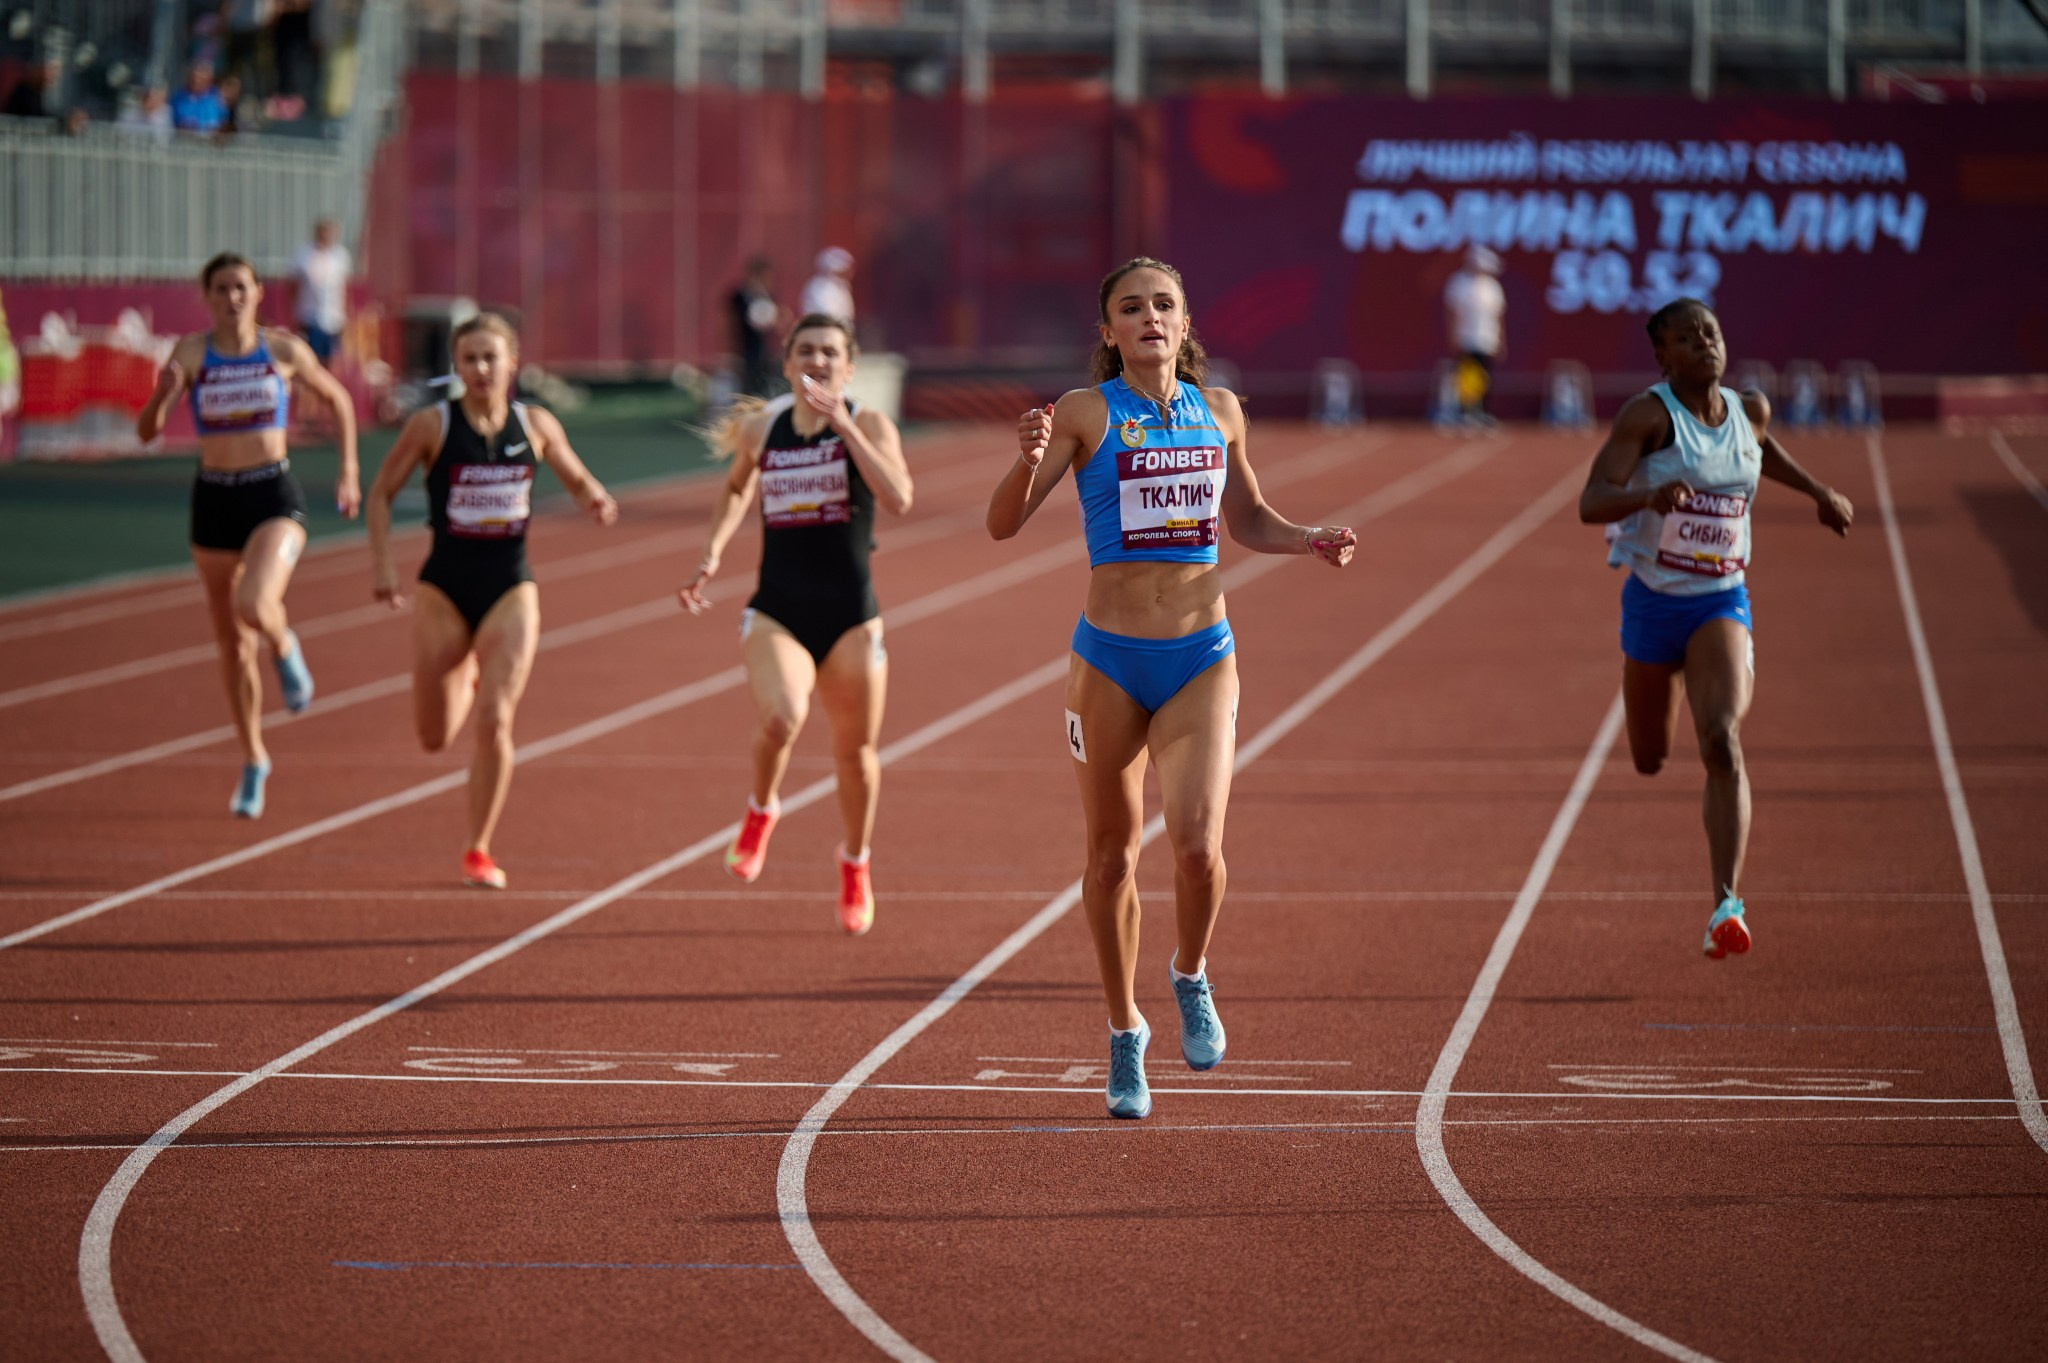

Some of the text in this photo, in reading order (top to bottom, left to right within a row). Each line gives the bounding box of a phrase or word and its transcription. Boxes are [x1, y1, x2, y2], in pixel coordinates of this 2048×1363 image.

[1540, 140, 1750, 182] РЕЗУЛЬТАТ
[1755, 140, 1907, 183] СЕЗОНА
[1340, 188, 1927, 253] ПОЛИНА ТКАЛИЧ
[1131, 449, 1216, 471] FONBET
[1140, 483, 1214, 509] ТКАЛИЧ
[1128, 531, 1170, 541] КОРОЛЕВА
[1172, 530, 1201, 538] СПОРТА
[1070, 719, 1081, 753] 4
